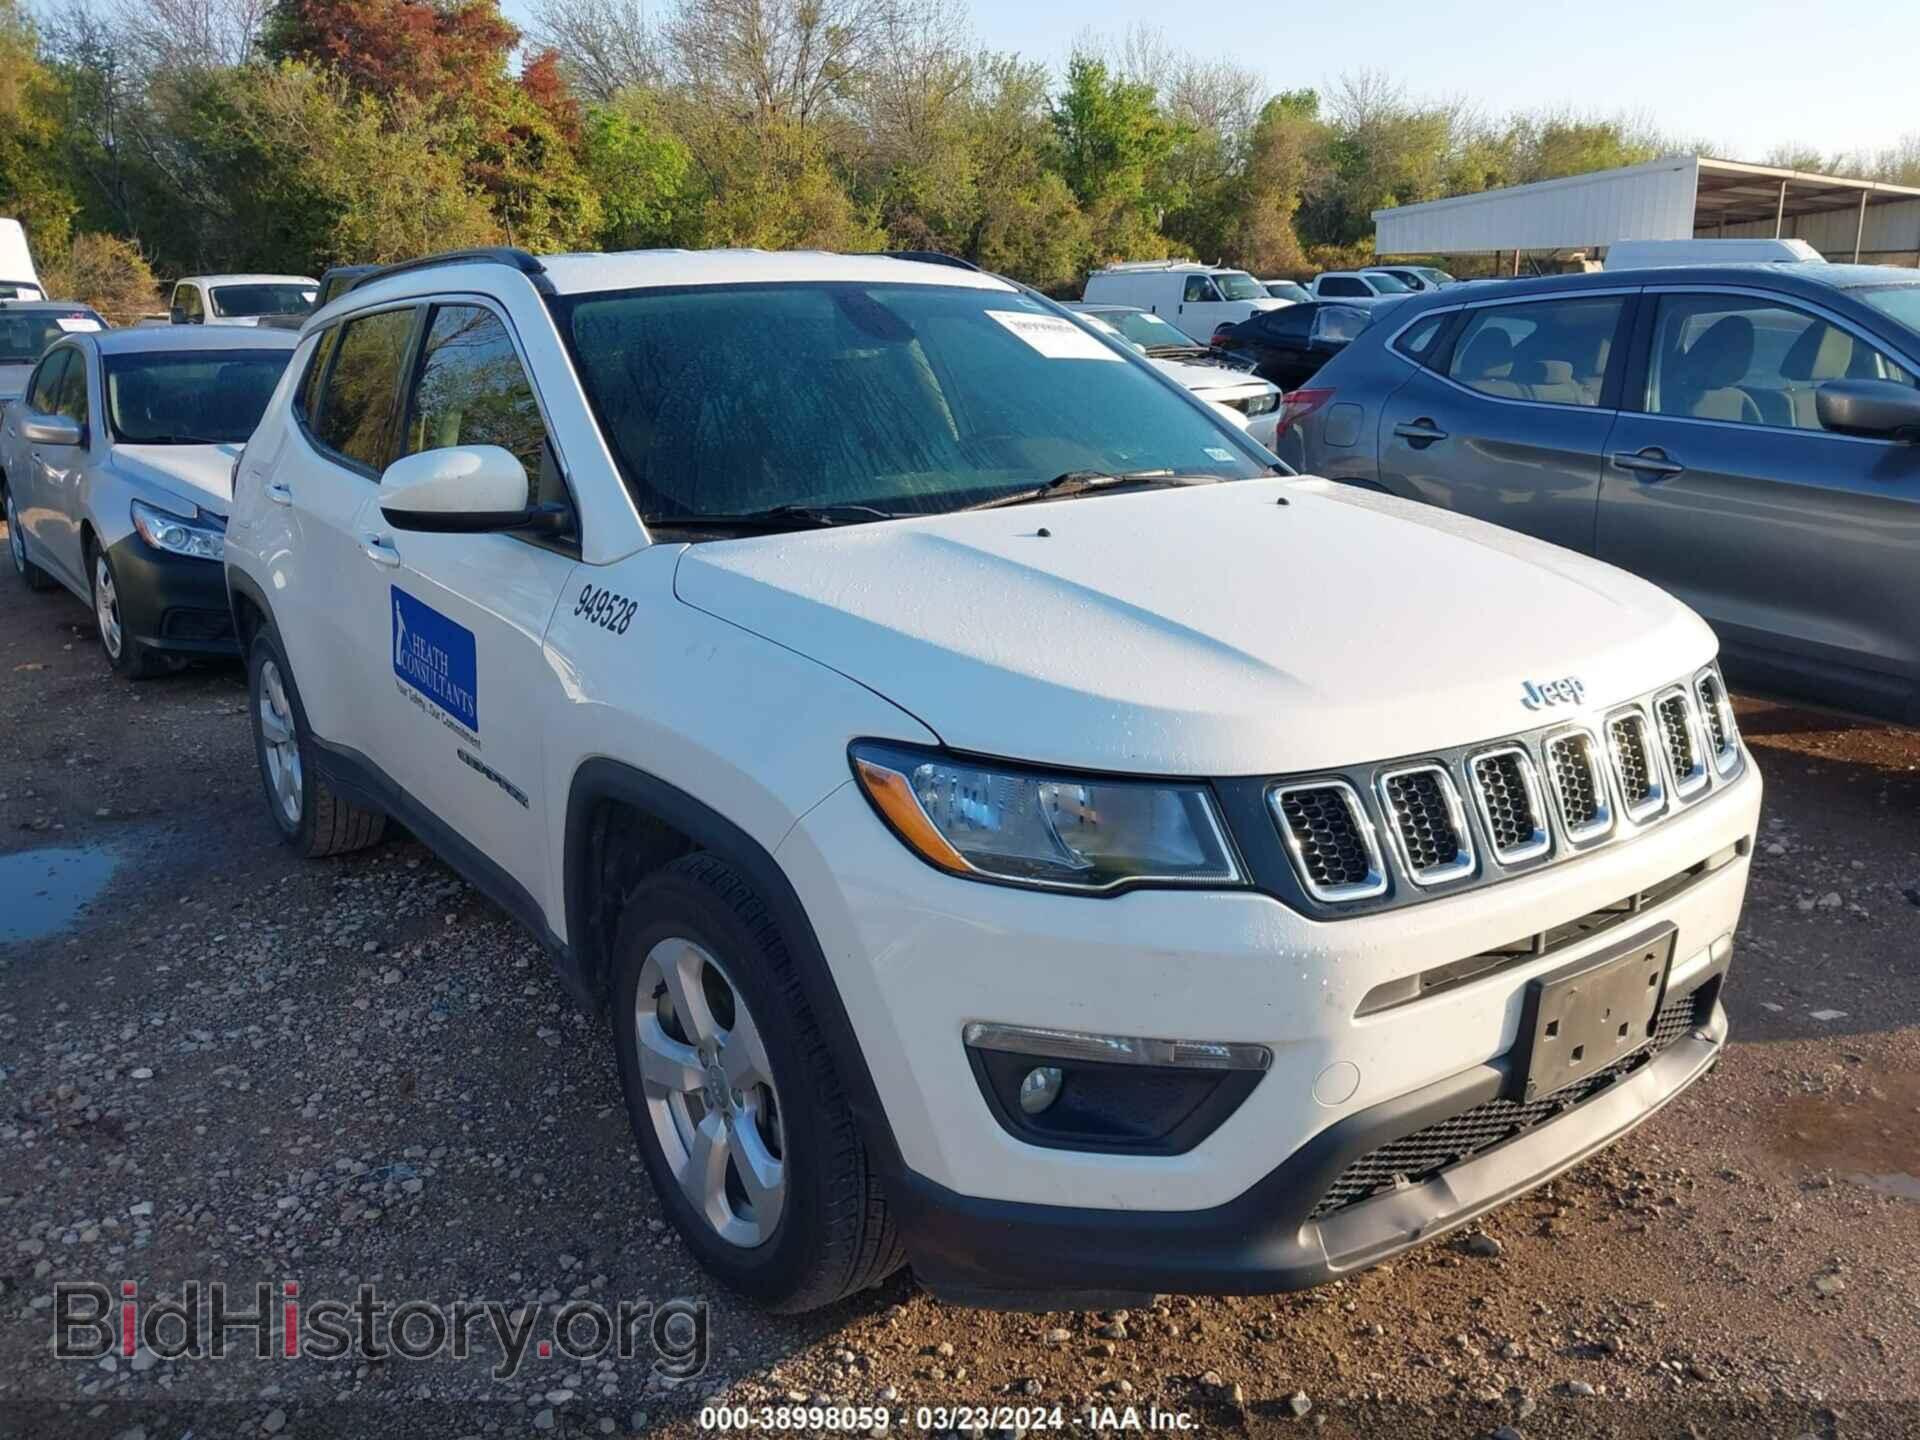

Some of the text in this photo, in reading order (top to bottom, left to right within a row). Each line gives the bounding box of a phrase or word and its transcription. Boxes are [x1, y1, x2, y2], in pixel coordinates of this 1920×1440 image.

[574, 585, 638, 635] 949528
[412, 632, 449, 676] HEATH
[401, 649, 475, 717] CONSULTANTS
[1520, 677, 1585, 711] Jeep
